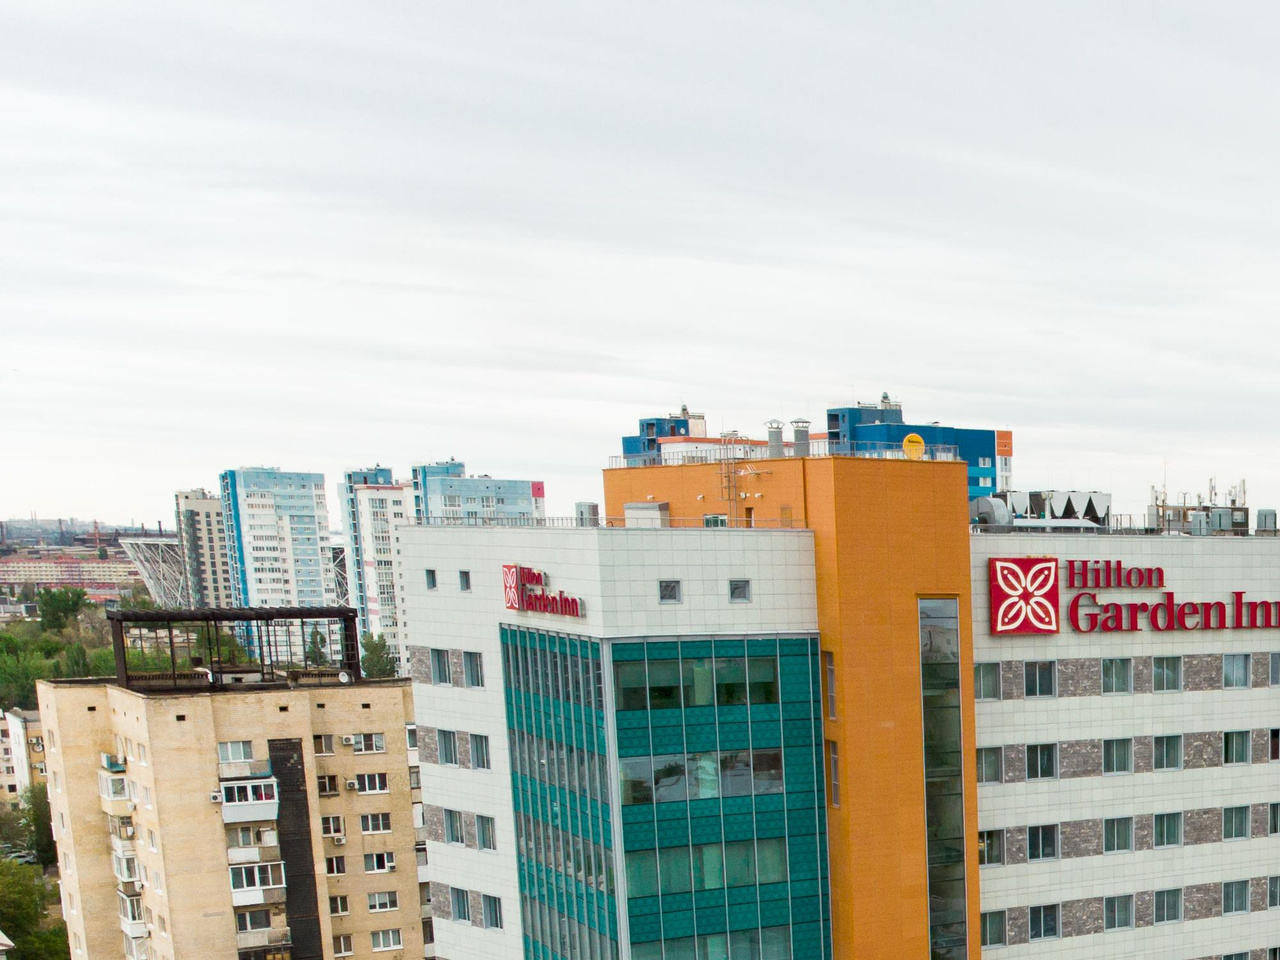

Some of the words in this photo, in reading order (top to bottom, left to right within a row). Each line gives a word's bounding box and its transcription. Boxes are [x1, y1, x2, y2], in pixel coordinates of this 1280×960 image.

[520, 567, 544, 585] Hilton
[1066, 560, 1166, 589] Hilton
[521, 585, 558, 614] Garden
[558, 590, 580, 617] Inn
